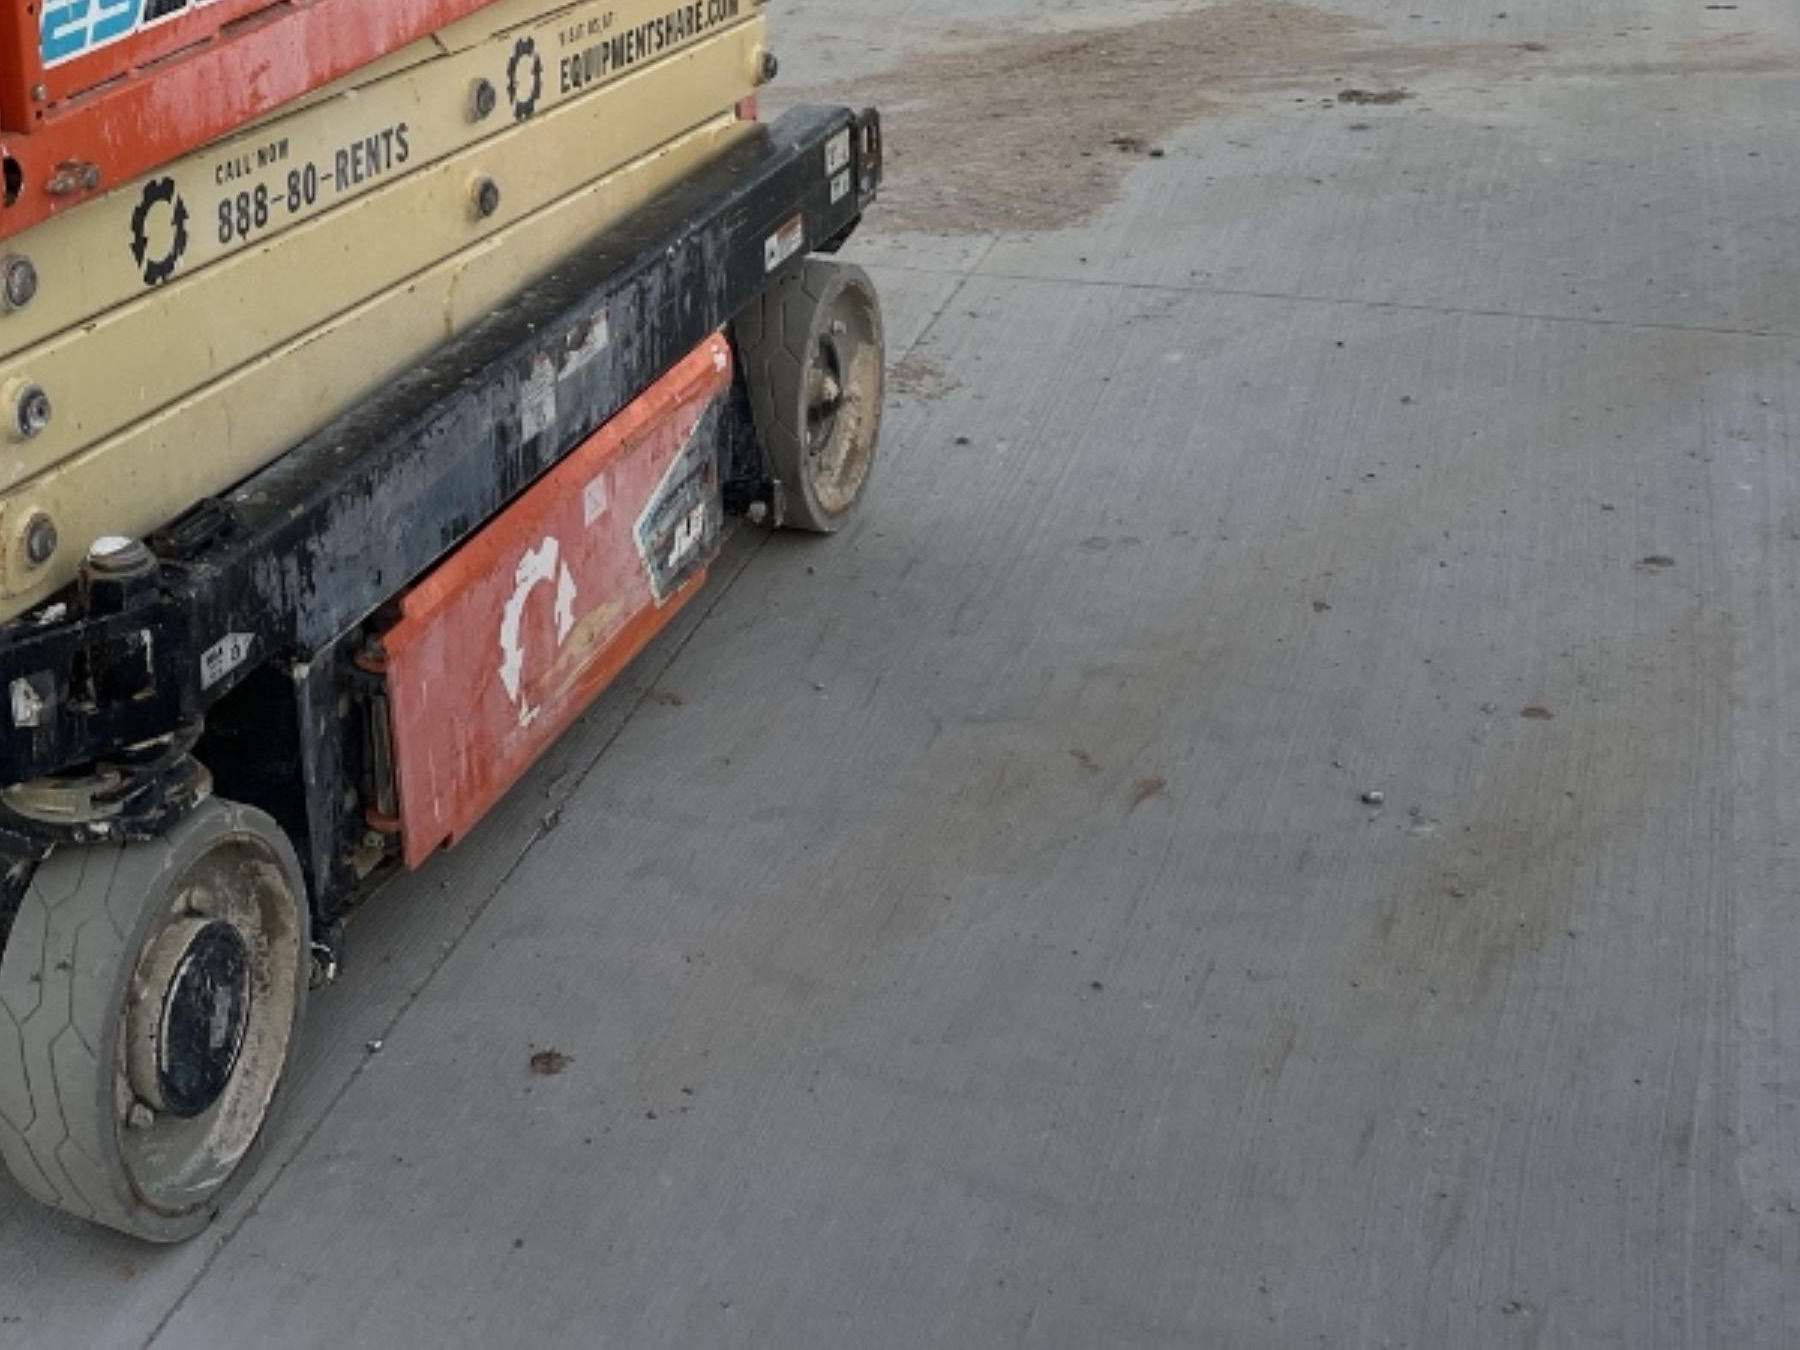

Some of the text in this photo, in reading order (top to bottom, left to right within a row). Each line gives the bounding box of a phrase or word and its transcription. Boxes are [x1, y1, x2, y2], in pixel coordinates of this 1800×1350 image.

[215, 137, 290, 186] CALL NOW
[218, 122, 409, 244] 888-80-RENTS
